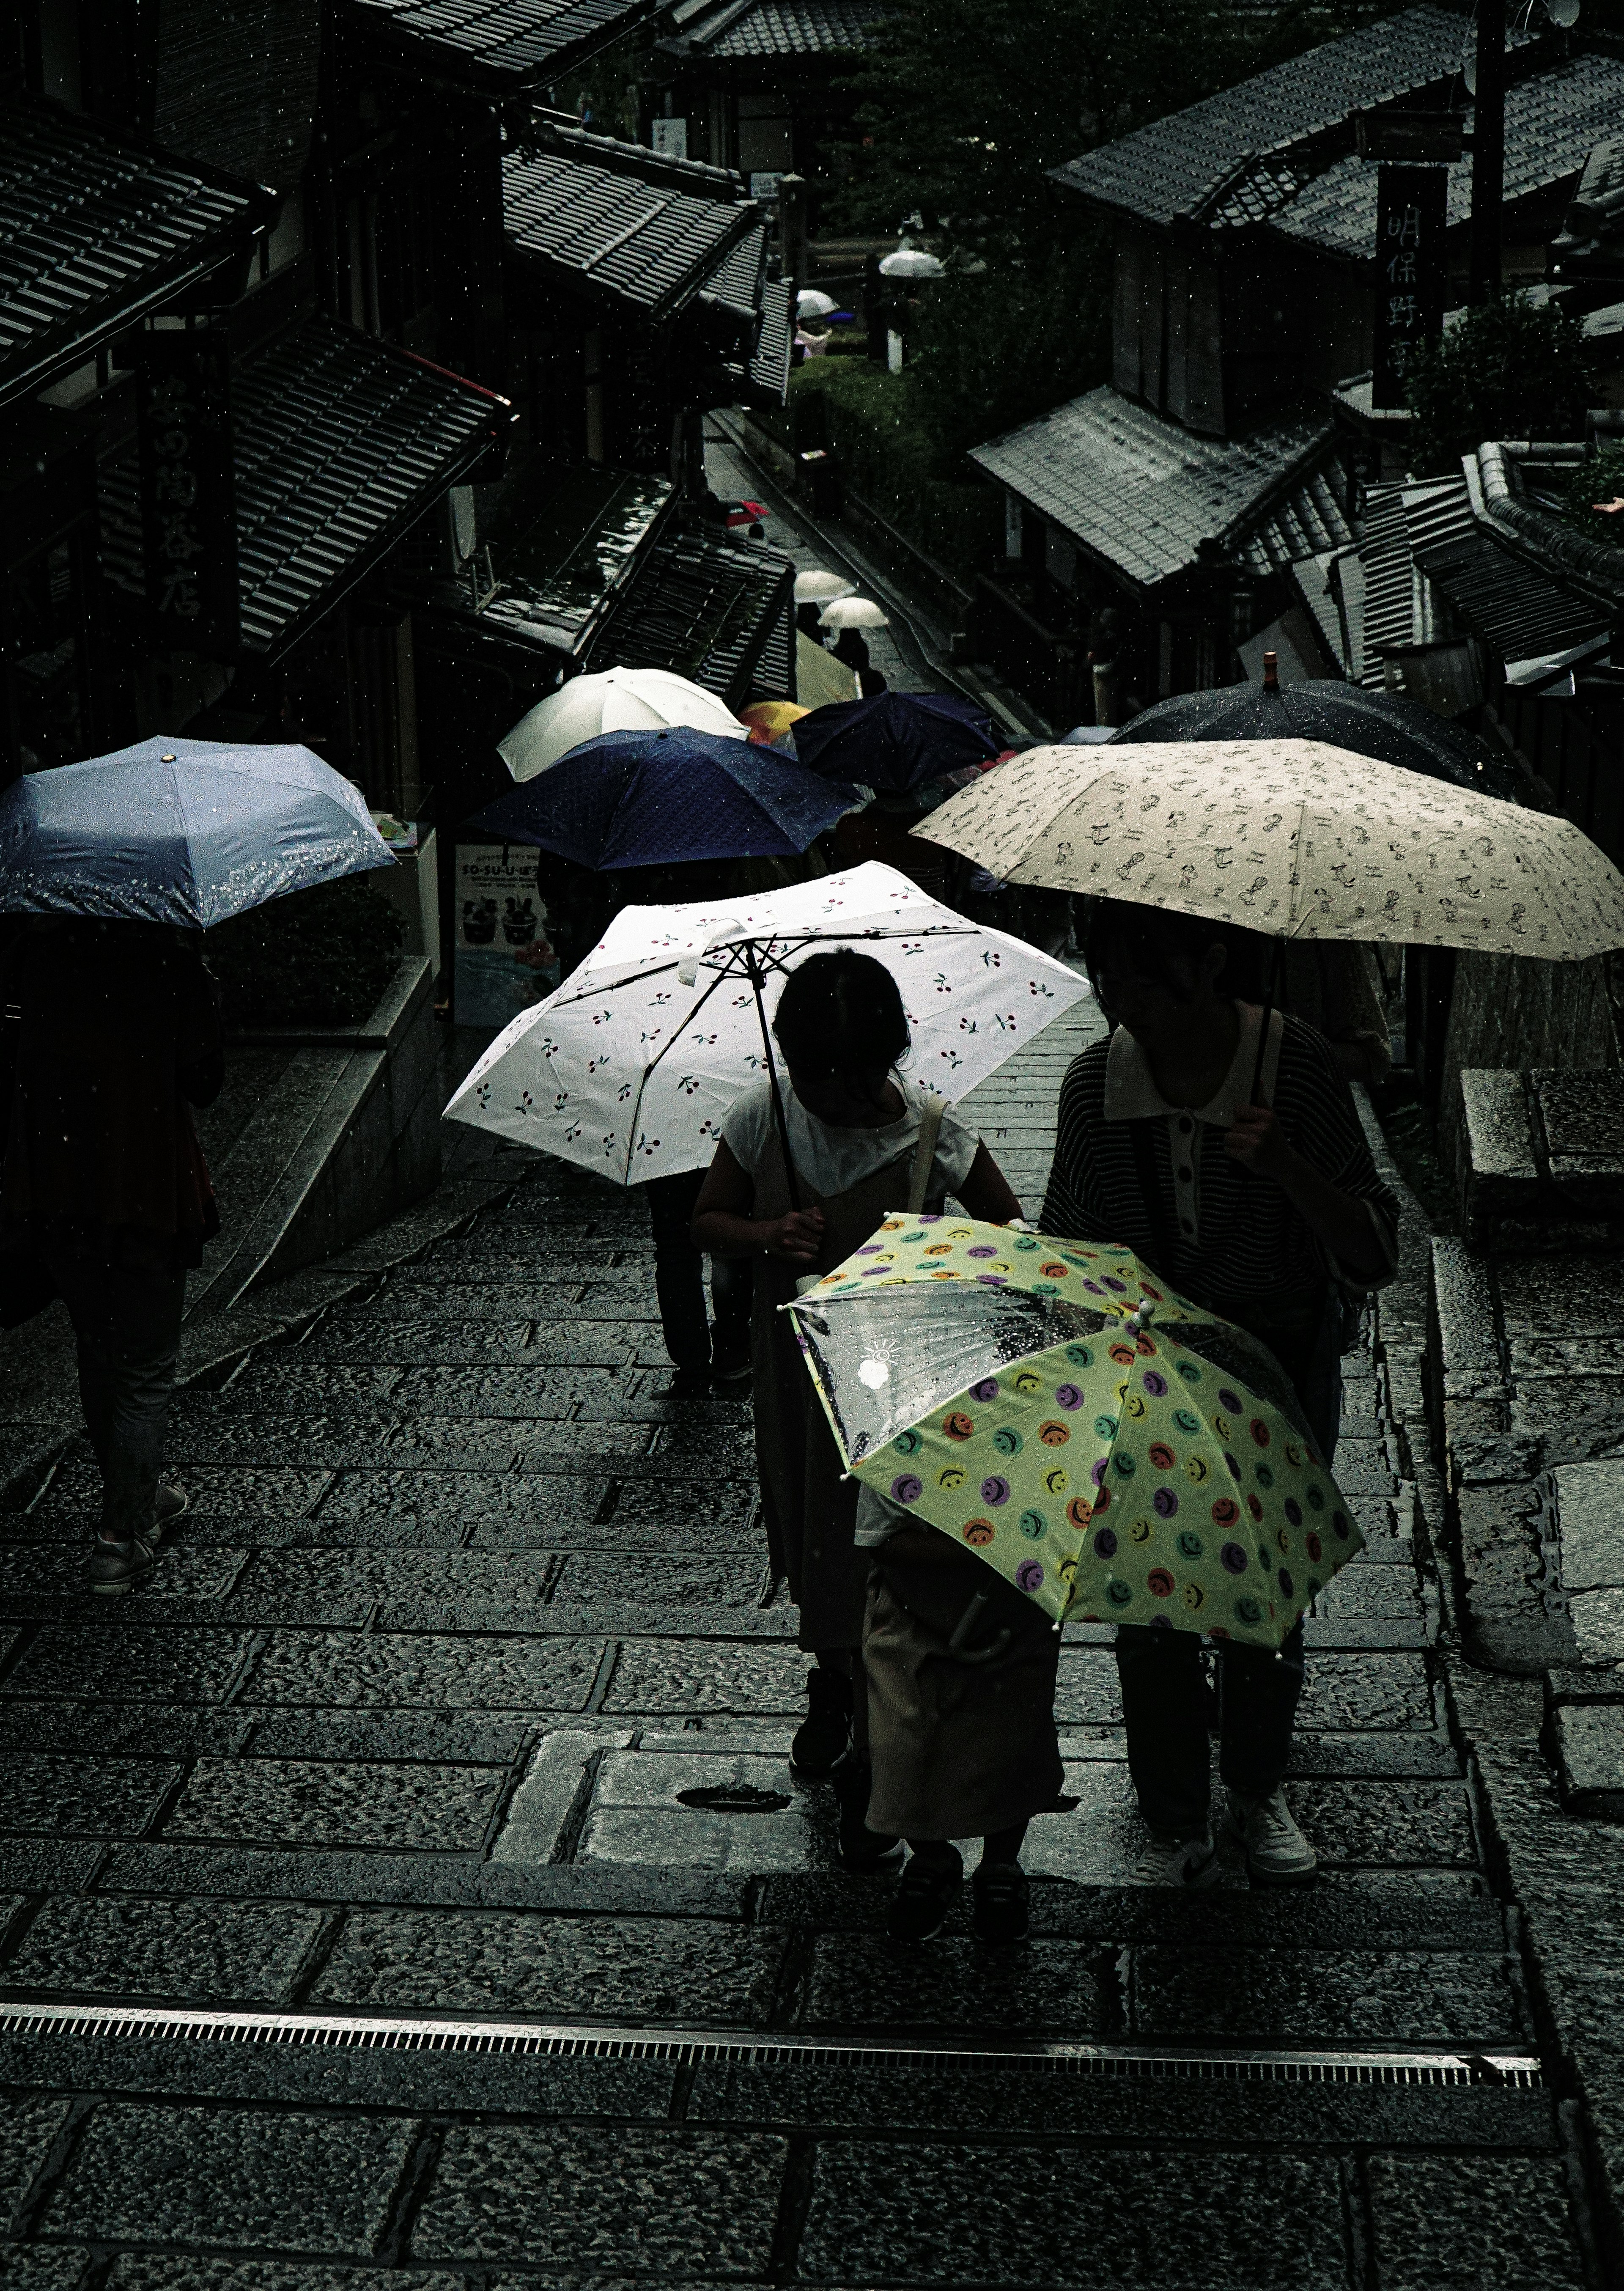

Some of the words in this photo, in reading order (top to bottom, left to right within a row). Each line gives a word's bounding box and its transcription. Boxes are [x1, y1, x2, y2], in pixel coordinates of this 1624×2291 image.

[1386, 206, 1421, 379] 明保野亭
[146, 373, 204, 618] 安の陶器店
